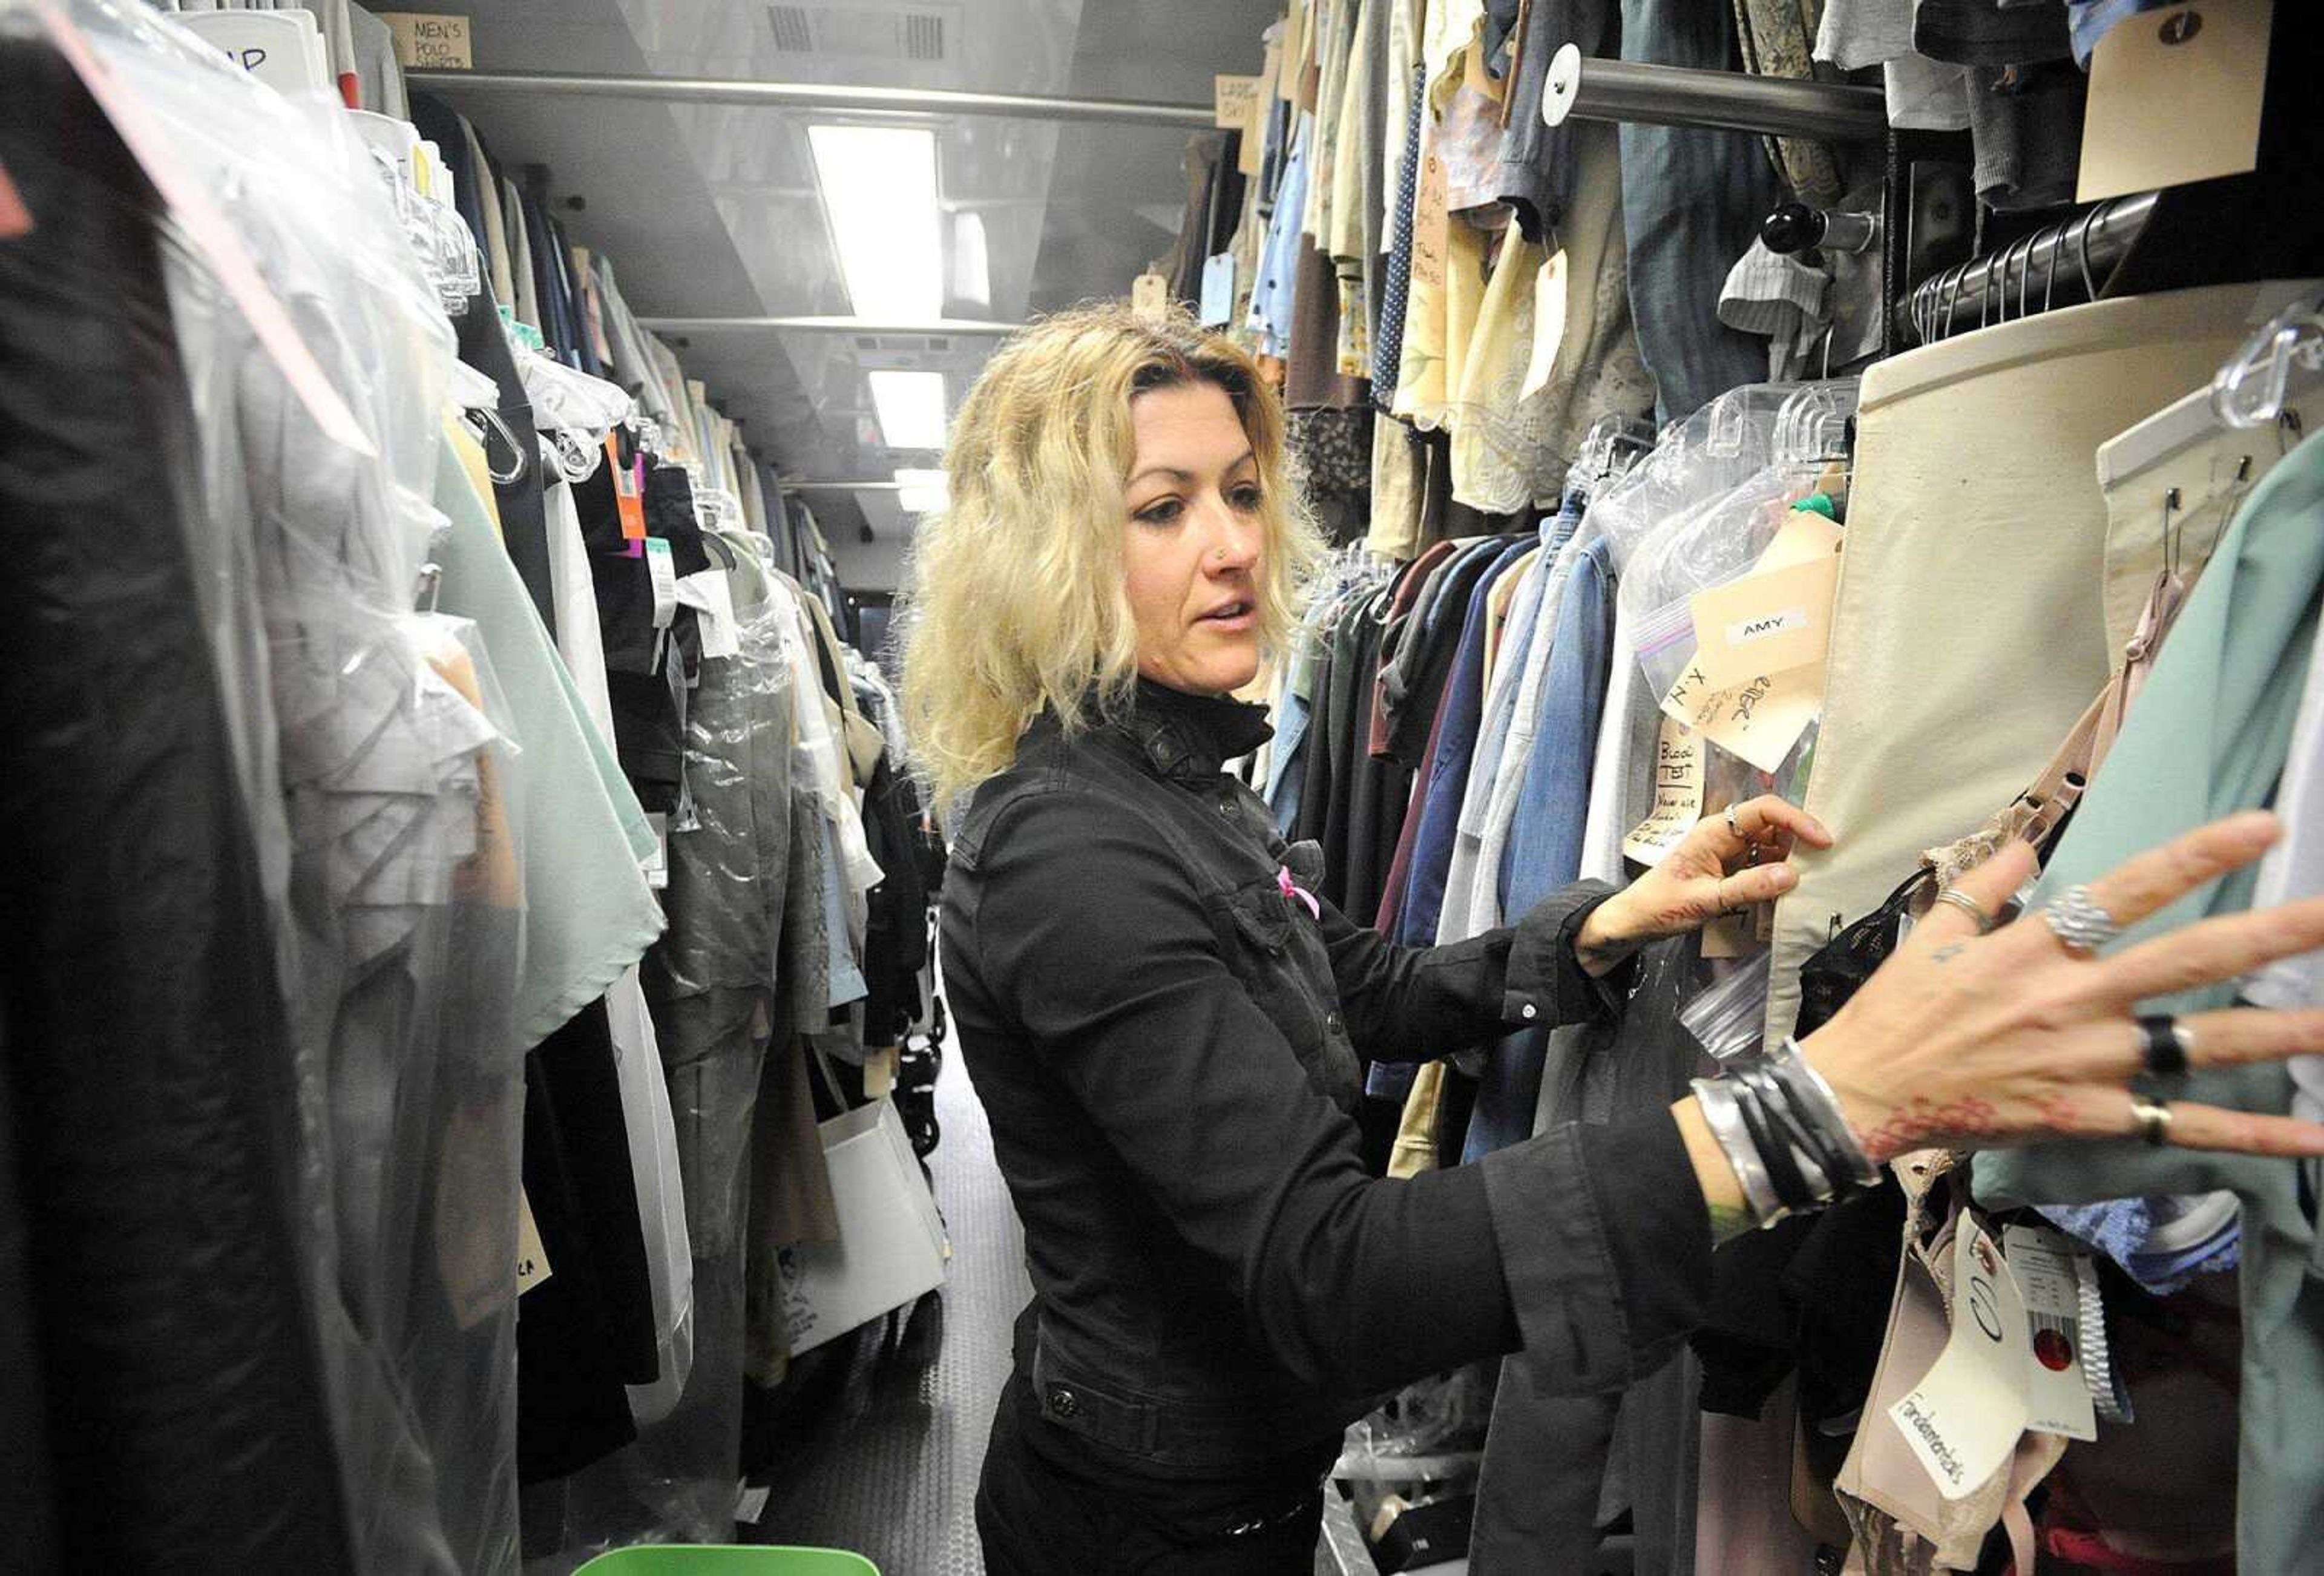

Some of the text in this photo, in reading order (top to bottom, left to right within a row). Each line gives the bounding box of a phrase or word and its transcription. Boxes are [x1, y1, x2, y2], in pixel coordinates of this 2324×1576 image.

[415, 22, 461, 37] MEN'S
[415, 40, 450, 56] POLO
[1744, 617, 1784, 636] AMY
